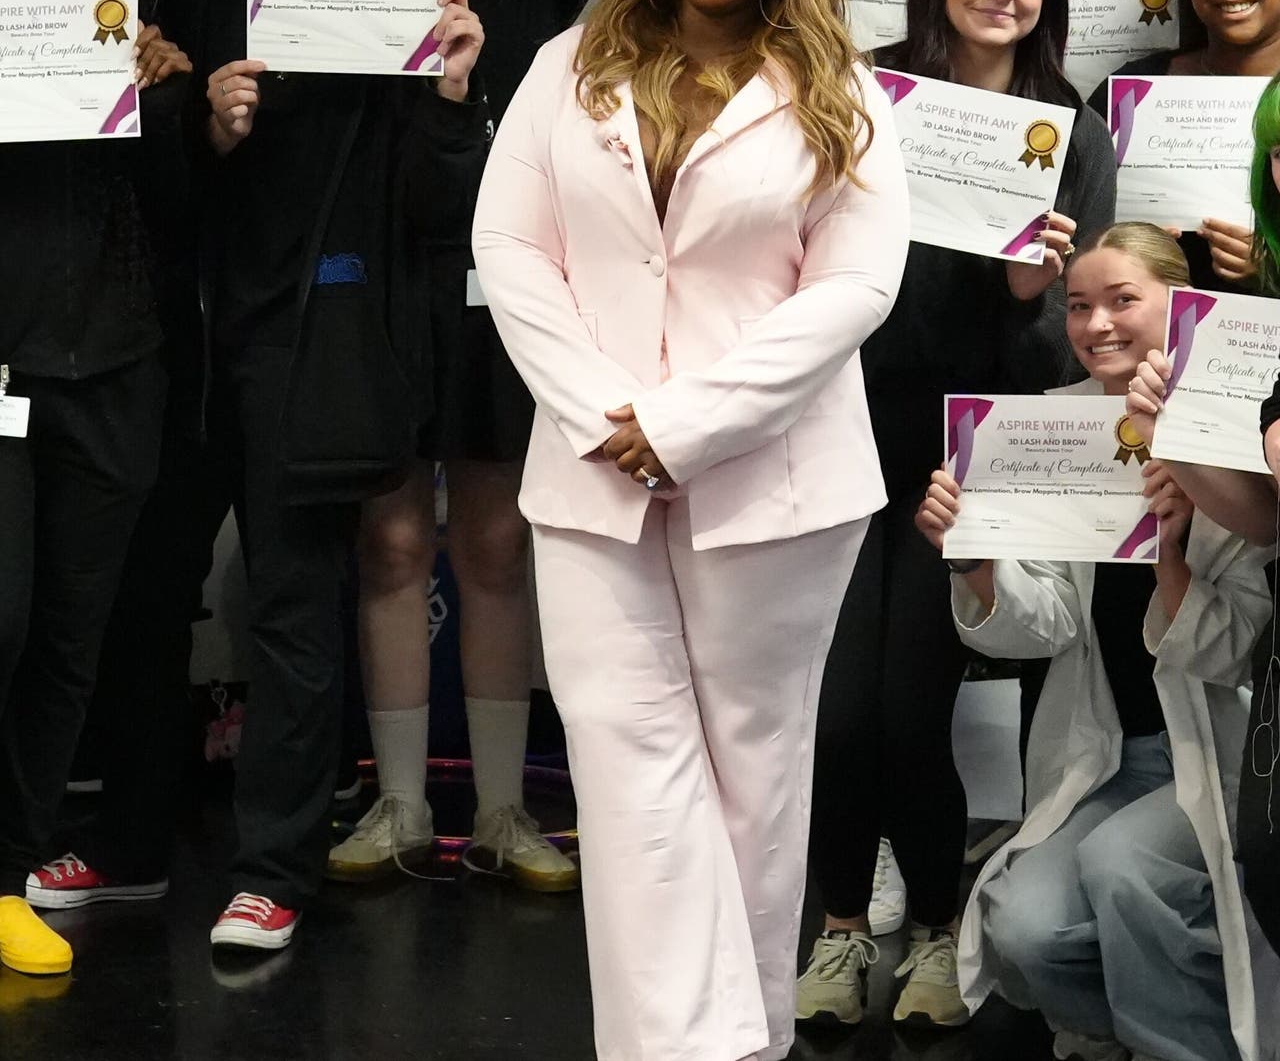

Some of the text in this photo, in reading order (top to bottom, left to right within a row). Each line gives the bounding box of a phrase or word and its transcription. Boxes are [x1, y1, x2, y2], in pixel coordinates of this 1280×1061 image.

[26, 5, 56, 16] WITH
[58, 5, 85, 15] AMY
[27, 23, 44, 31] AND
[45, 22, 69, 30] BROW
[28, 45, 40, 61] of
[41, 42, 94, 59] Completion
[914, 101, 1019, 131] ASPIRE WITH AMY
[900, 137, 1017, 174] Certificate of Completion
[1217, 319, 1260, 334] ASPIRE
[1238, 340, 1259, 350] LASH
[1260, 343, 1278, 352] AND
[1206, 358, 1271, 385] Certificate of
[997, 420, 1106, 431] ASPIRE WITH AMY
[1020, 438, 1041, 446] LASH
[1043, 438, 1061, 446] AND
[990, 458, 1115, 478] Certificate of Completion
